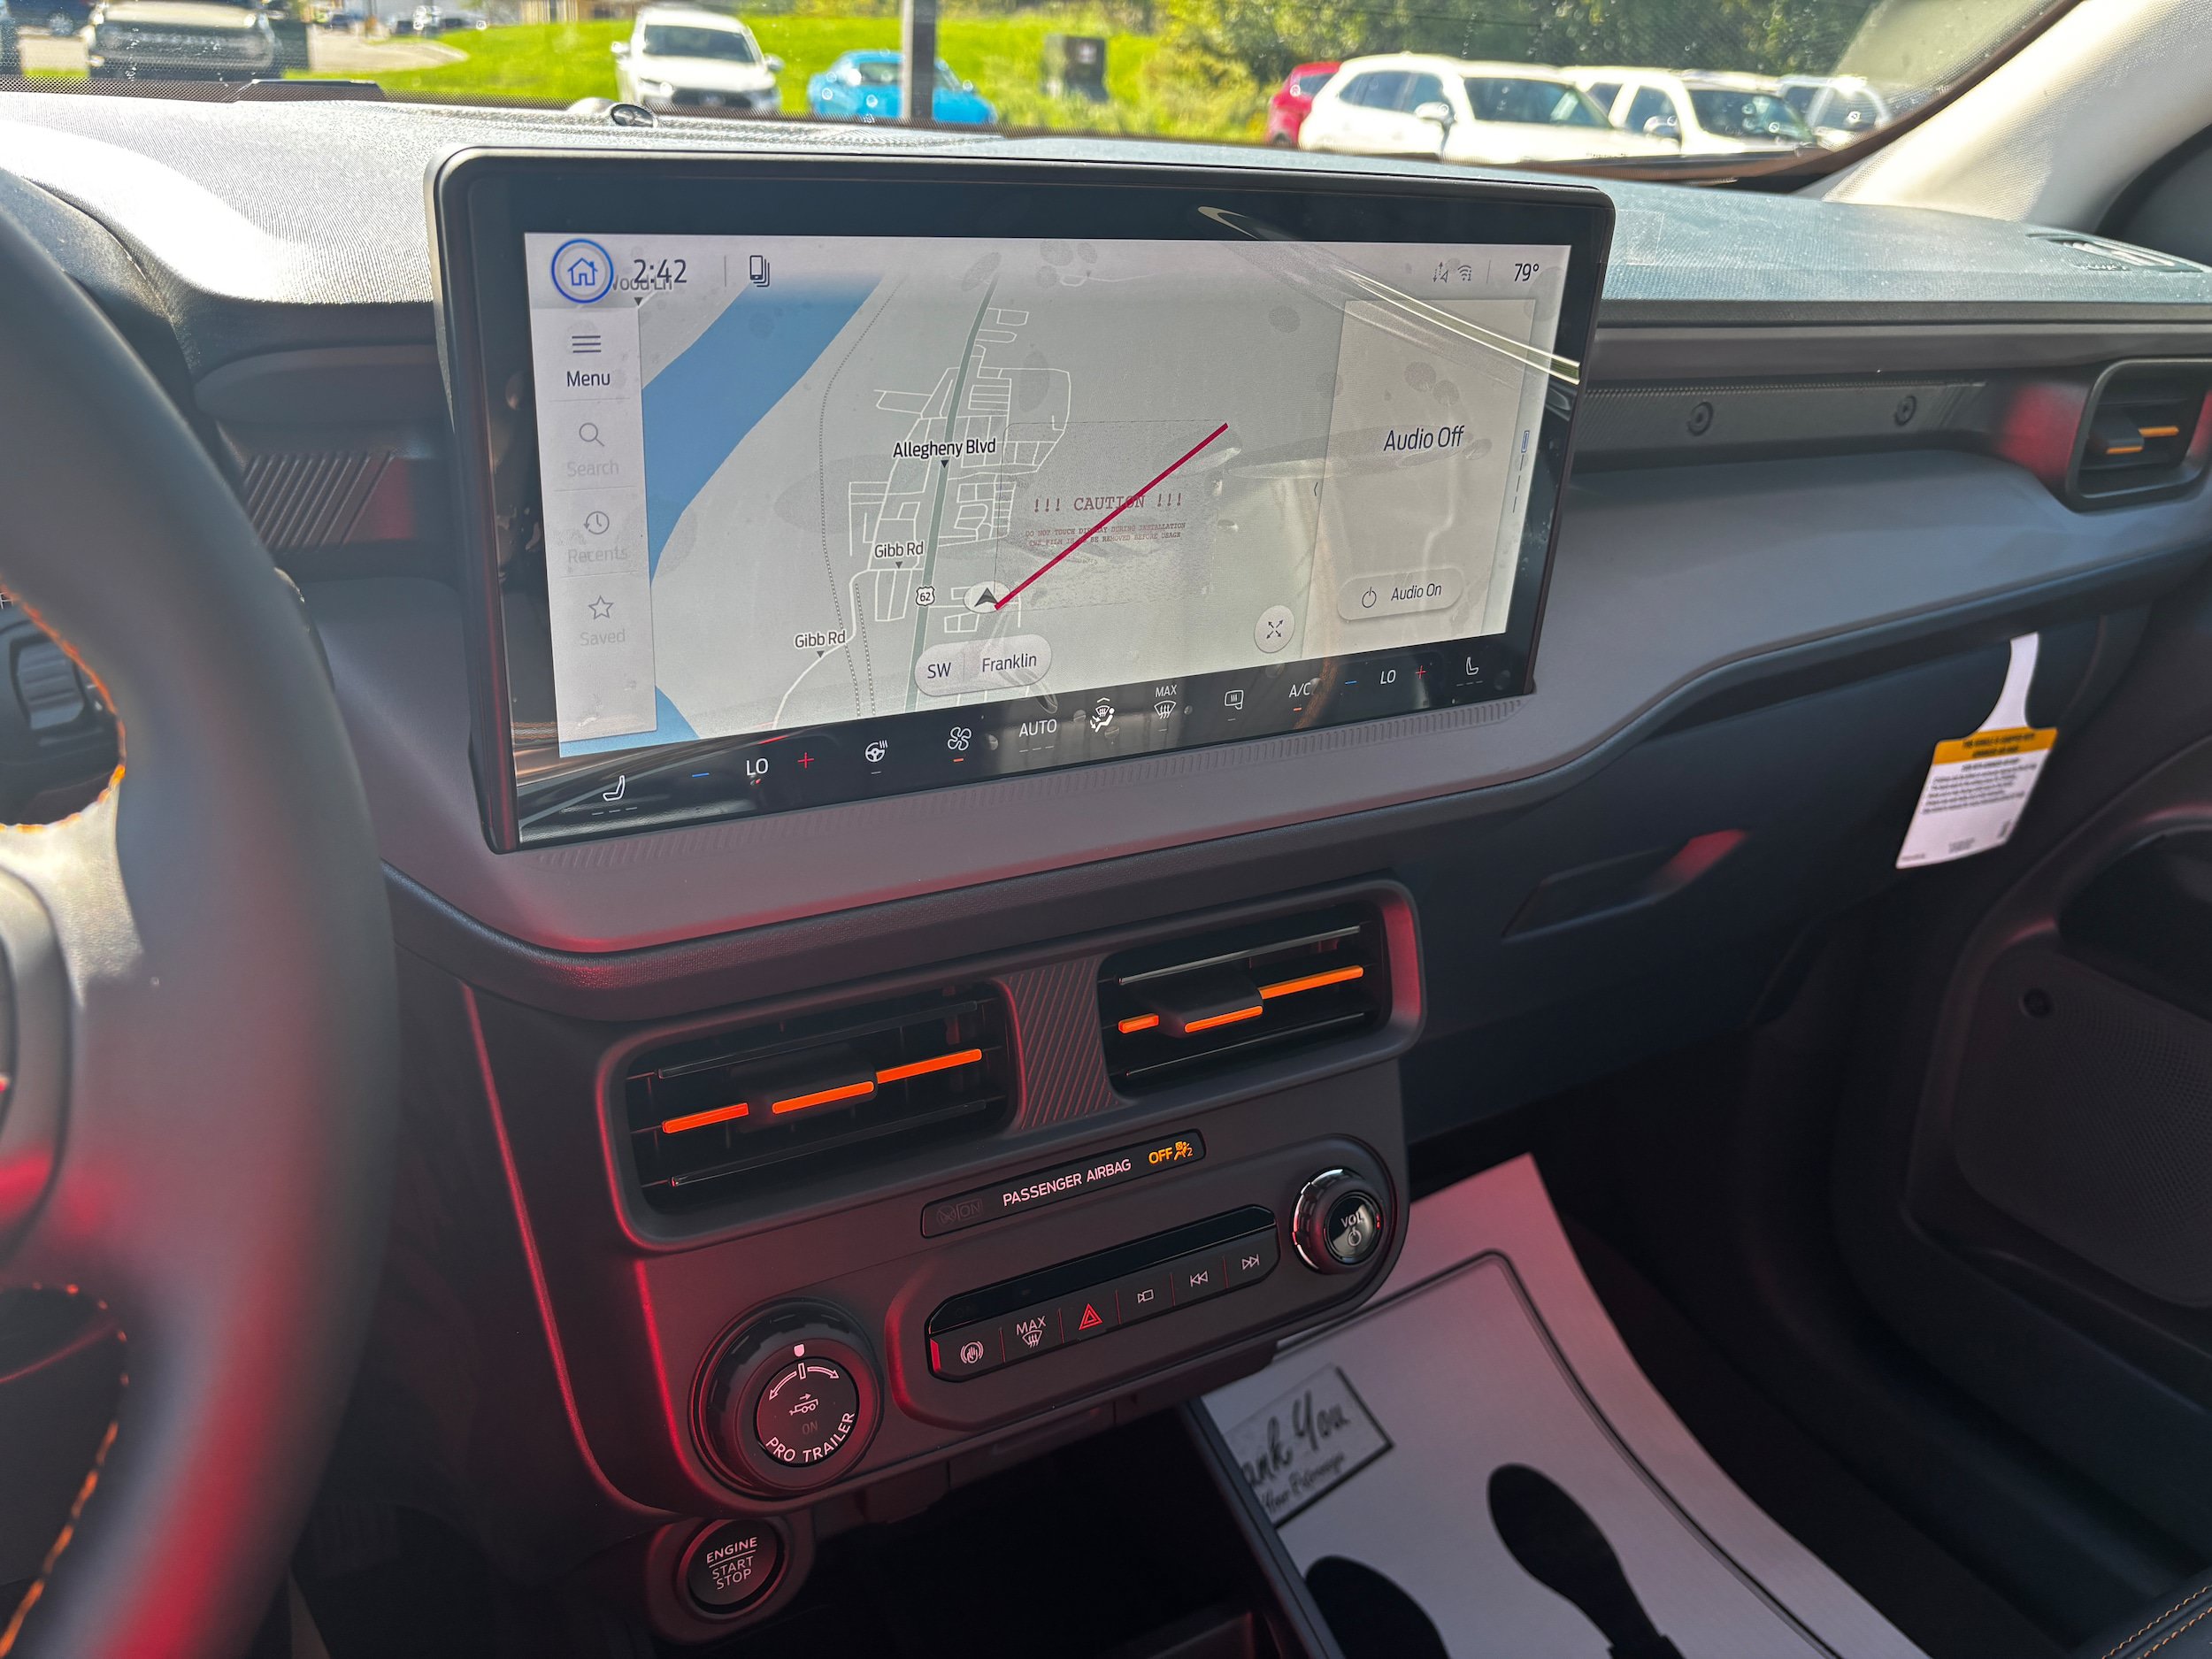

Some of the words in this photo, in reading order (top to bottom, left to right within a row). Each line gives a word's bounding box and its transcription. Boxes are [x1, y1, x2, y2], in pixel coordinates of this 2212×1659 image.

[634, 258, 687, 285] 2:42
[1514, 263, 1540, 281] 79°
[566, 371, 611, 387] Menu
[1383, 427, 1433, 451] Audio
[1437, 425, 1465, 448] Off
[892, 441, 963, 459] Allegheny
[965, 438, 996, 454] Blvd
[566, 460, 619, 478] Search
[1073, 495, 1146, 511] CAUTION
[567, 545, 628, 565] Recents
[874, 543, 904, 558] Gibb
[906, 541, 925, 557] Rd
[919, 590, 932, 603] 62
[1391, 585, 1424, 602] Audio
[1426, 583, 1442, 598] On
[580, 628, 626, 647] Saved
[795, 633, 826, 649] Gibb
[827, 630, 846, 645] Rd
[926, 661, 952, 680] SW
[981, 652, 1038, 673] Franklin
[1379, 669, 1396, 685] LO
[1155, 684, 1178, 698] MAX
[1288, 682, 1311, 698] A/C
[1018, 718, 1058, 738] AUTO
[746, 757, 769, 777] LO
[1148, 1147, 1173, 1165] OFF
[1002, 1172, 1082, 1207] PASSENGER
[1086, 1158, 1133, 1184] AIRBAG
[1340, 1212, 1364, 1228] VOL
[1016, 1315, 1048, 1336] MAX
[802, 1420, 819, 1435] ON
[765, 1436, 796, 1463] PRO
[803, 1412, 856, 1463] TRAILER
[706, 1536, 758, 1564] ENGINE
[711, 1555, 754, 1580] START
[715, 1567, 752, 1591] STOP
